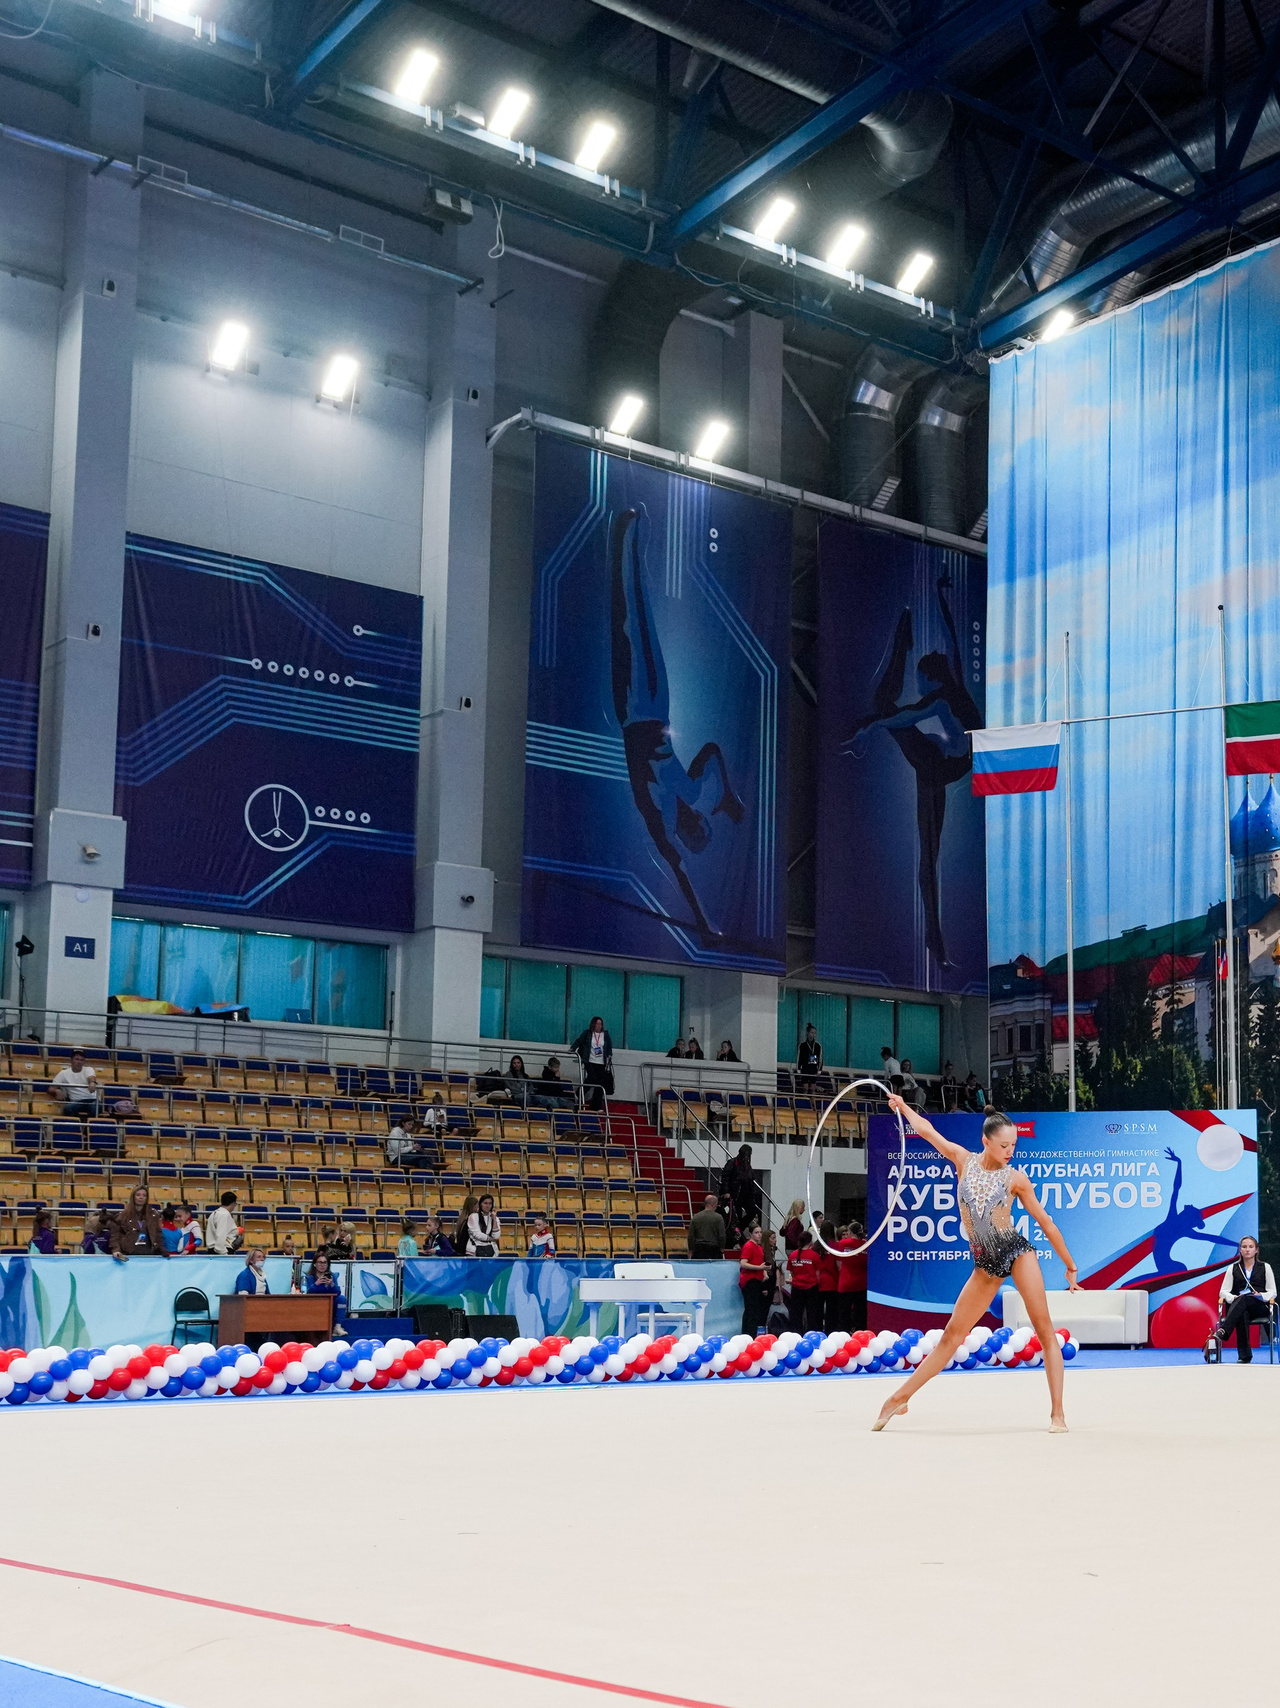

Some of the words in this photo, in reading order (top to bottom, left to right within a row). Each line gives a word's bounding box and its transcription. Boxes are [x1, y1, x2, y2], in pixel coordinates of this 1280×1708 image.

[1016, 1150, 1028, 1159] ПО
[1029, 1148, 1106, 1159] ХУДОЖЕСТВЕННОЙ
[1107, 1149, 1160, 1157] ГИМНАСТИКЕ
[1110, 1162, 1160, 1177] ЛИГА
[887, 1184, 955, 1211] КУБ
[887, 1250, 904, 1261] 30
[906, 1250, 971, 1261] СЕНТЯБРЯ
